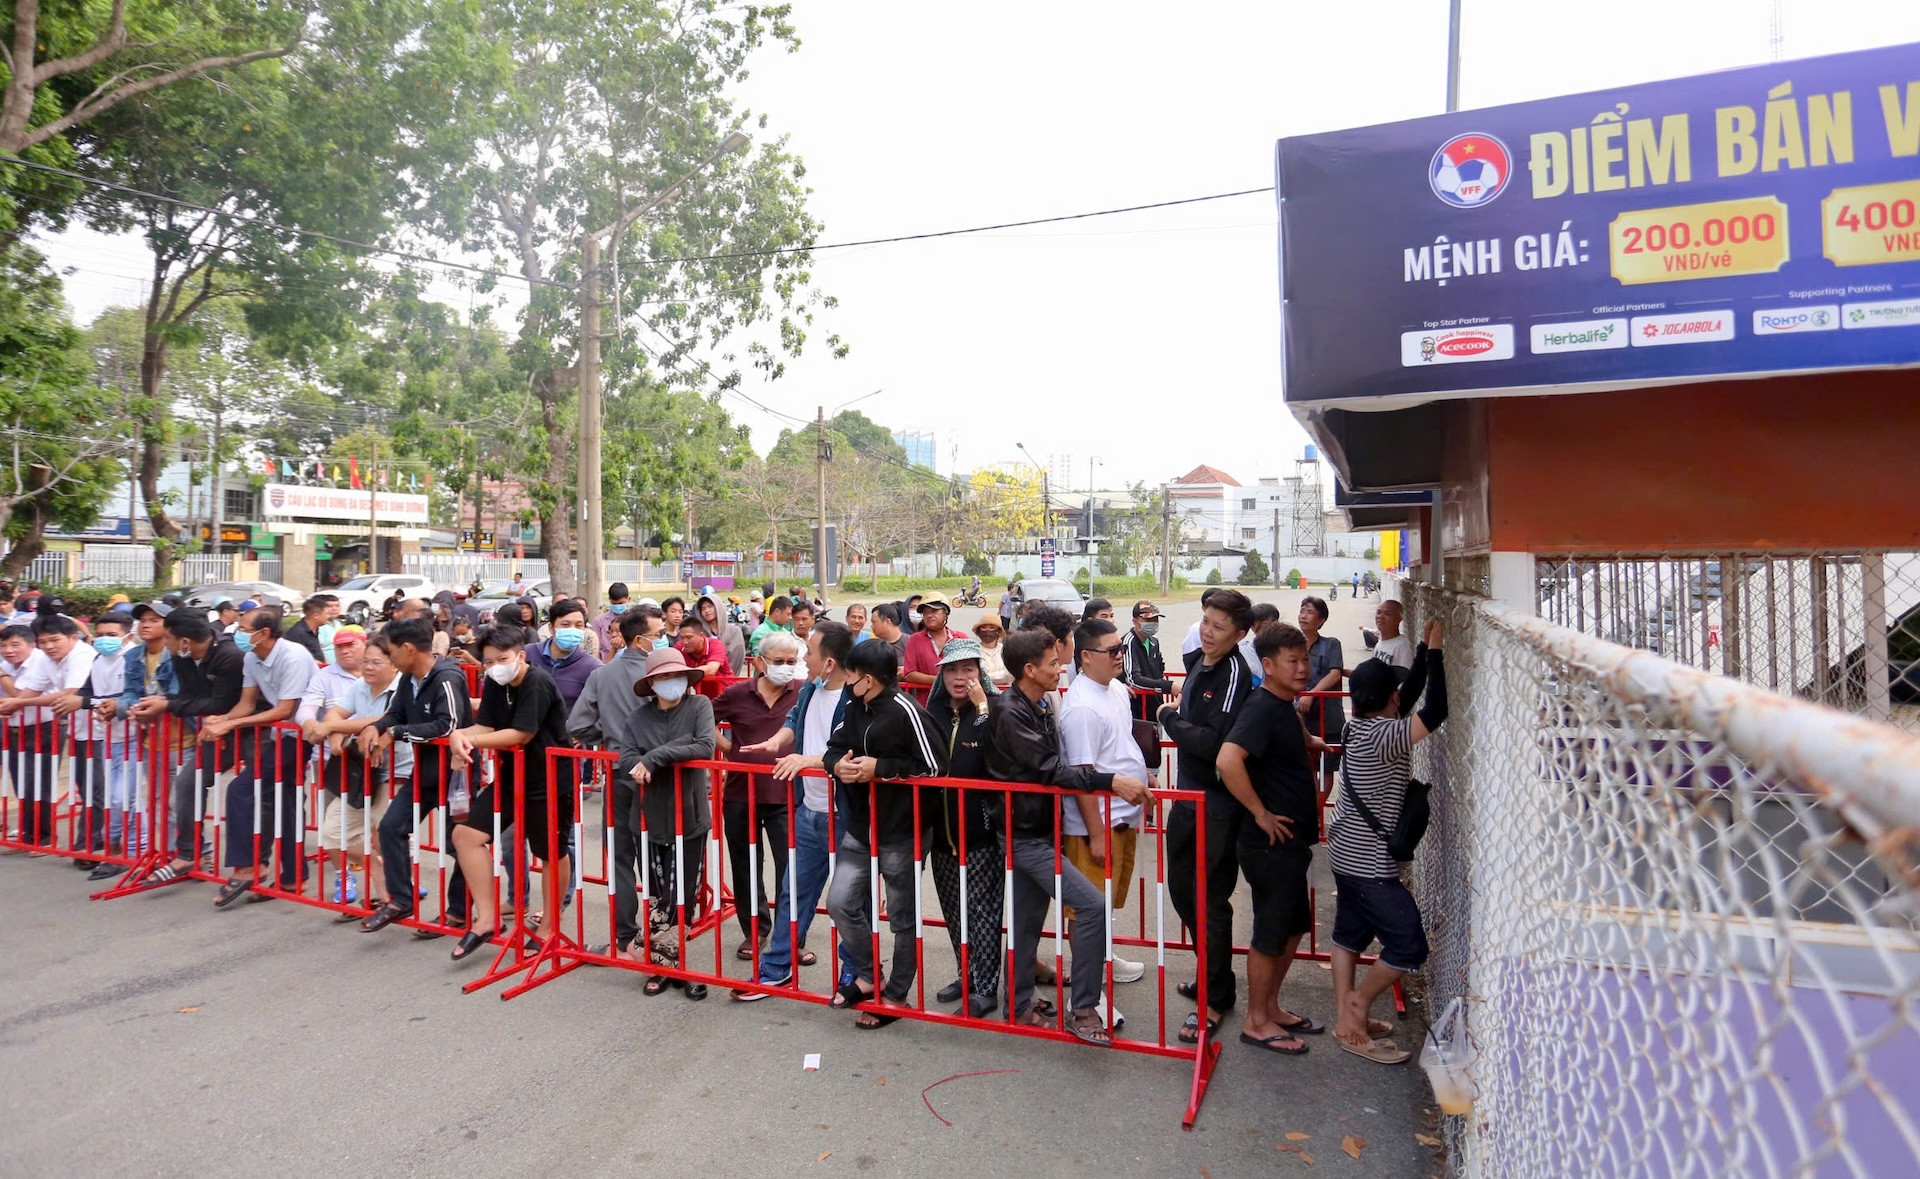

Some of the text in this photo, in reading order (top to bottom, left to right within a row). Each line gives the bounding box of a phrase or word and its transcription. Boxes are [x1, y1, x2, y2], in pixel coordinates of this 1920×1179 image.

[1528, 102, 1691, 199] ĐIỂM
[1715, 80, 1854, 178] BÁN
[1461, 186, 1481, 195] VFF
[1836, 198, 1920, 233] 400
[1622, 213, 1775, 254] 200.000
[1404, 220, 1589, 287] MỆNH GIÁ:
[1663, 250, 1732, 273] VNĐ/vé
[1788, 284, 1893, 299] Supporting Partners
[1592, 302, 1666, 314] Official Partners
[1423, 316, 1490, 329] Top Star Partner
[1661, 320, 1722, 336] JOGARBOLA
[1436, 329, 1494, 342] Cook happiness
[1544, 331, 1608, 346] Herbalife
